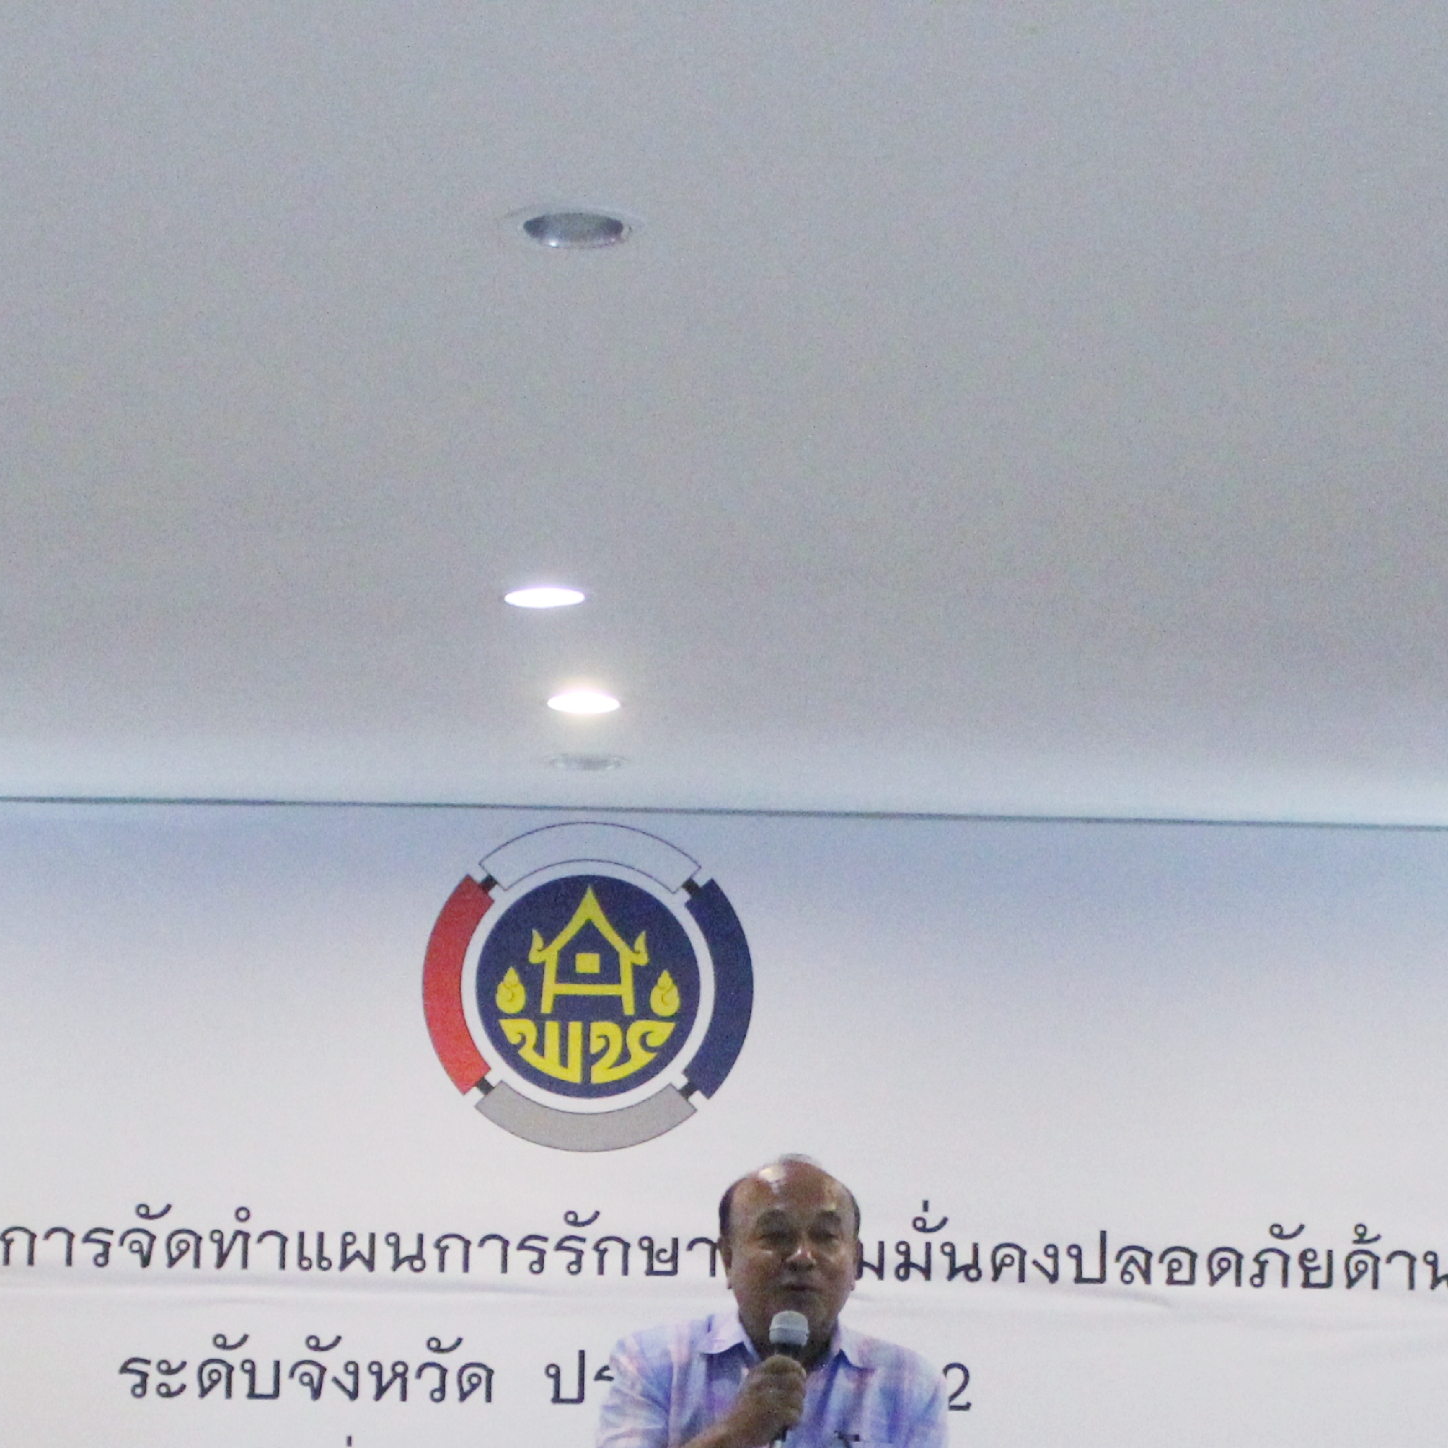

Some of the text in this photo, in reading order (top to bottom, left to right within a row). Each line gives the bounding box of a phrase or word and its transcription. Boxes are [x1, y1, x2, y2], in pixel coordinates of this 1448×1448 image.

[118, 1333, 495, 1404] ระดับจังหวัด
